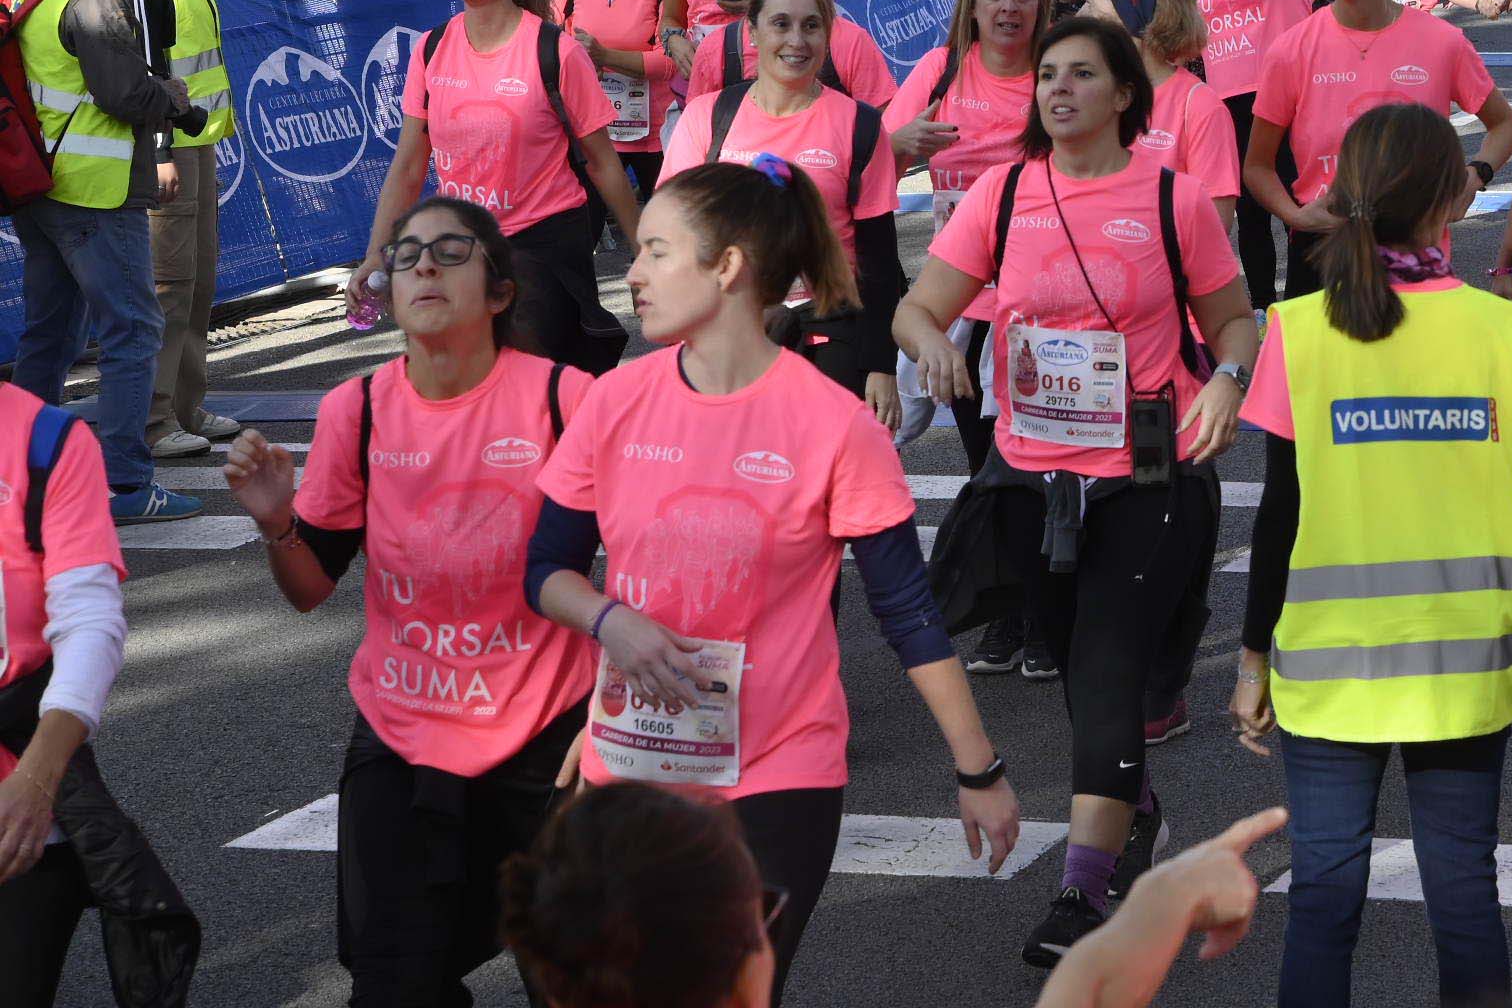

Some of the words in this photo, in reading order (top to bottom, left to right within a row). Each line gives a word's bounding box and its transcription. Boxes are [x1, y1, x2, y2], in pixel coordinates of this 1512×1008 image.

[1207, 34, 1253, 60] SUMA
[1312, 71, 1357, 84] OYSHO
[952, 95, 990, 112] OYSHO
[257, 102, 362, 154] ASTURIANA
[935, 169, 964, 191] TU
[1010, 216, 1061, 230] OYSHO
[1106, 225, 1148, 239] ASTURIANA
[1041, 374, 1082, 392] 016
[1045, 394, 1077, 408] 29775
[1048, 410, 1058, 418] DE
[1058, 411, 1067, 419] LA
[1068, 412, 1093, 421] MUJER
[1335, 408, 1487, 433] VOLUNTARIS
[1020, 419, 1049, 433] OYSHO
[1075, 429, 1116, 438] Santander
[485, 449, 538, 462] ASTURIANA
[624, 443, 684, 464] OYSHO
[739, 460, 792, 477] ASTURIANA
[379, 568, 414, 604] TU
[379, 656, 493, 704] SUMA
[633, 717, 674, 736] 16605
[636, 737, 648, 747] DE
[650, 740, 662, 750] LA
[663, 742, 696, 753] MUJER
[673, 762, 726, 774] Santander
